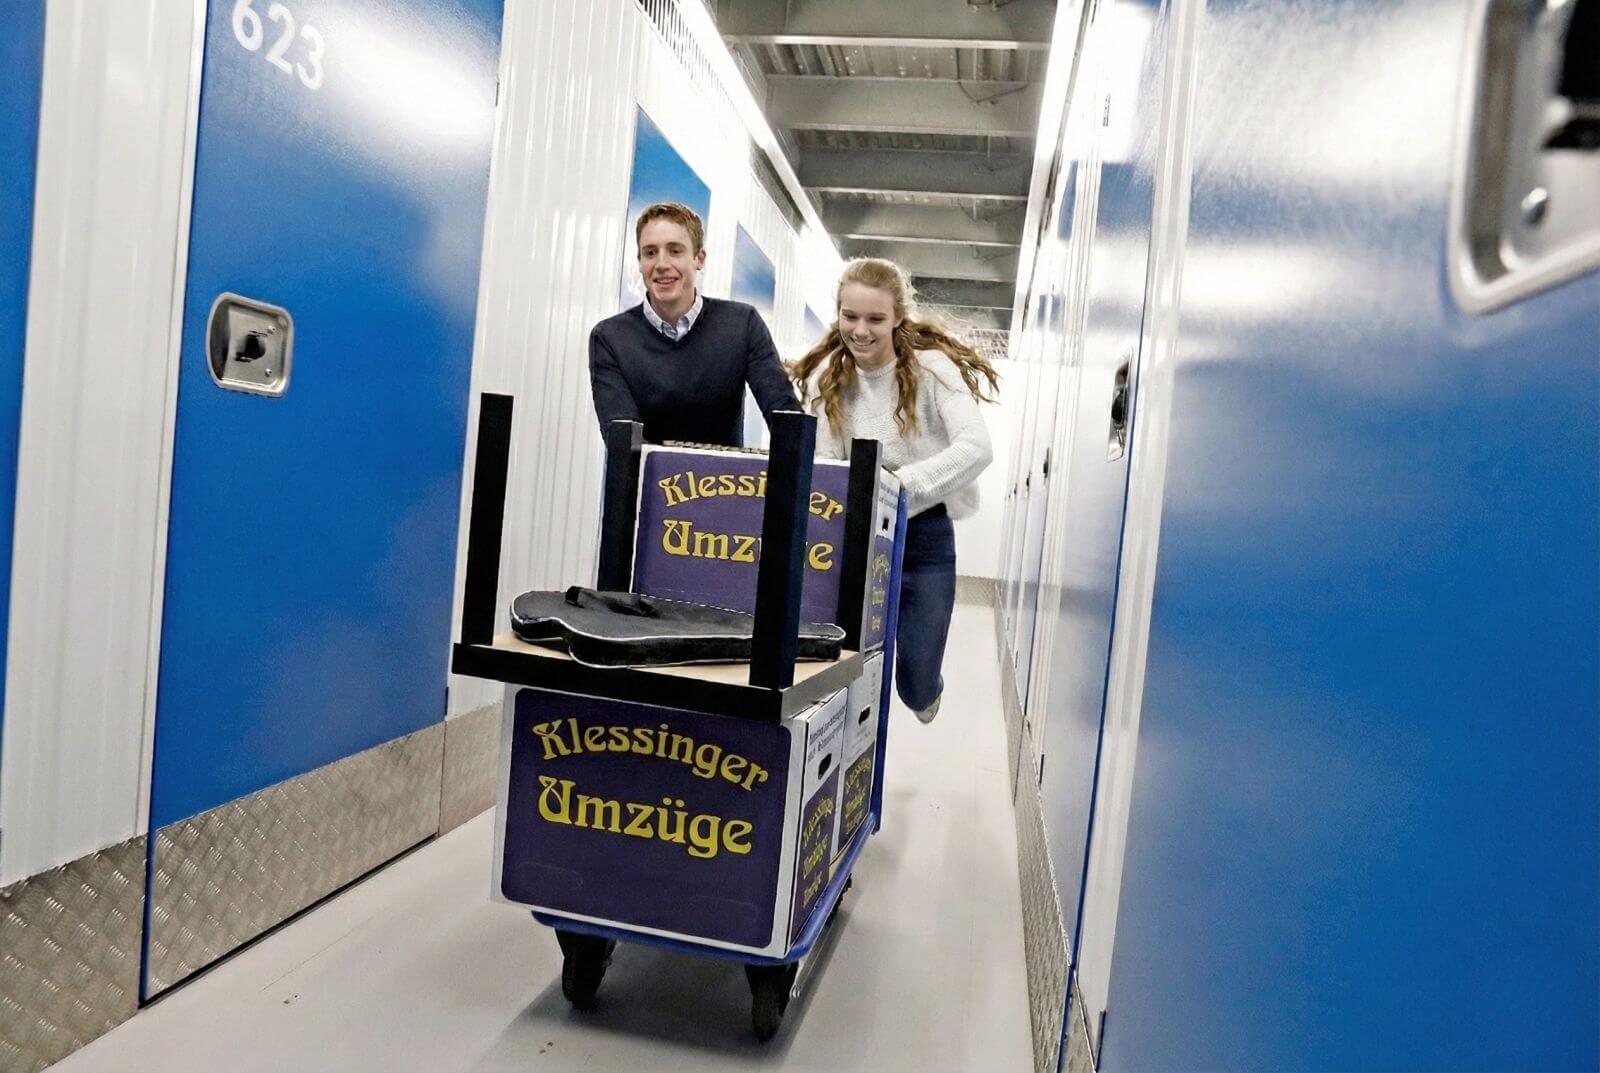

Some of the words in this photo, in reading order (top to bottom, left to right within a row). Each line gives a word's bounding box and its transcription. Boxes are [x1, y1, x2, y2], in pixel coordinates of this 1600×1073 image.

[231, 0, 324, 90] 623
[658, 470, 844, 520] Klessier
[662, 518, 834, 571] Umze
[531, 717, 769, 792] Klessinger
[537, 774, 754, 859] Umzüge
